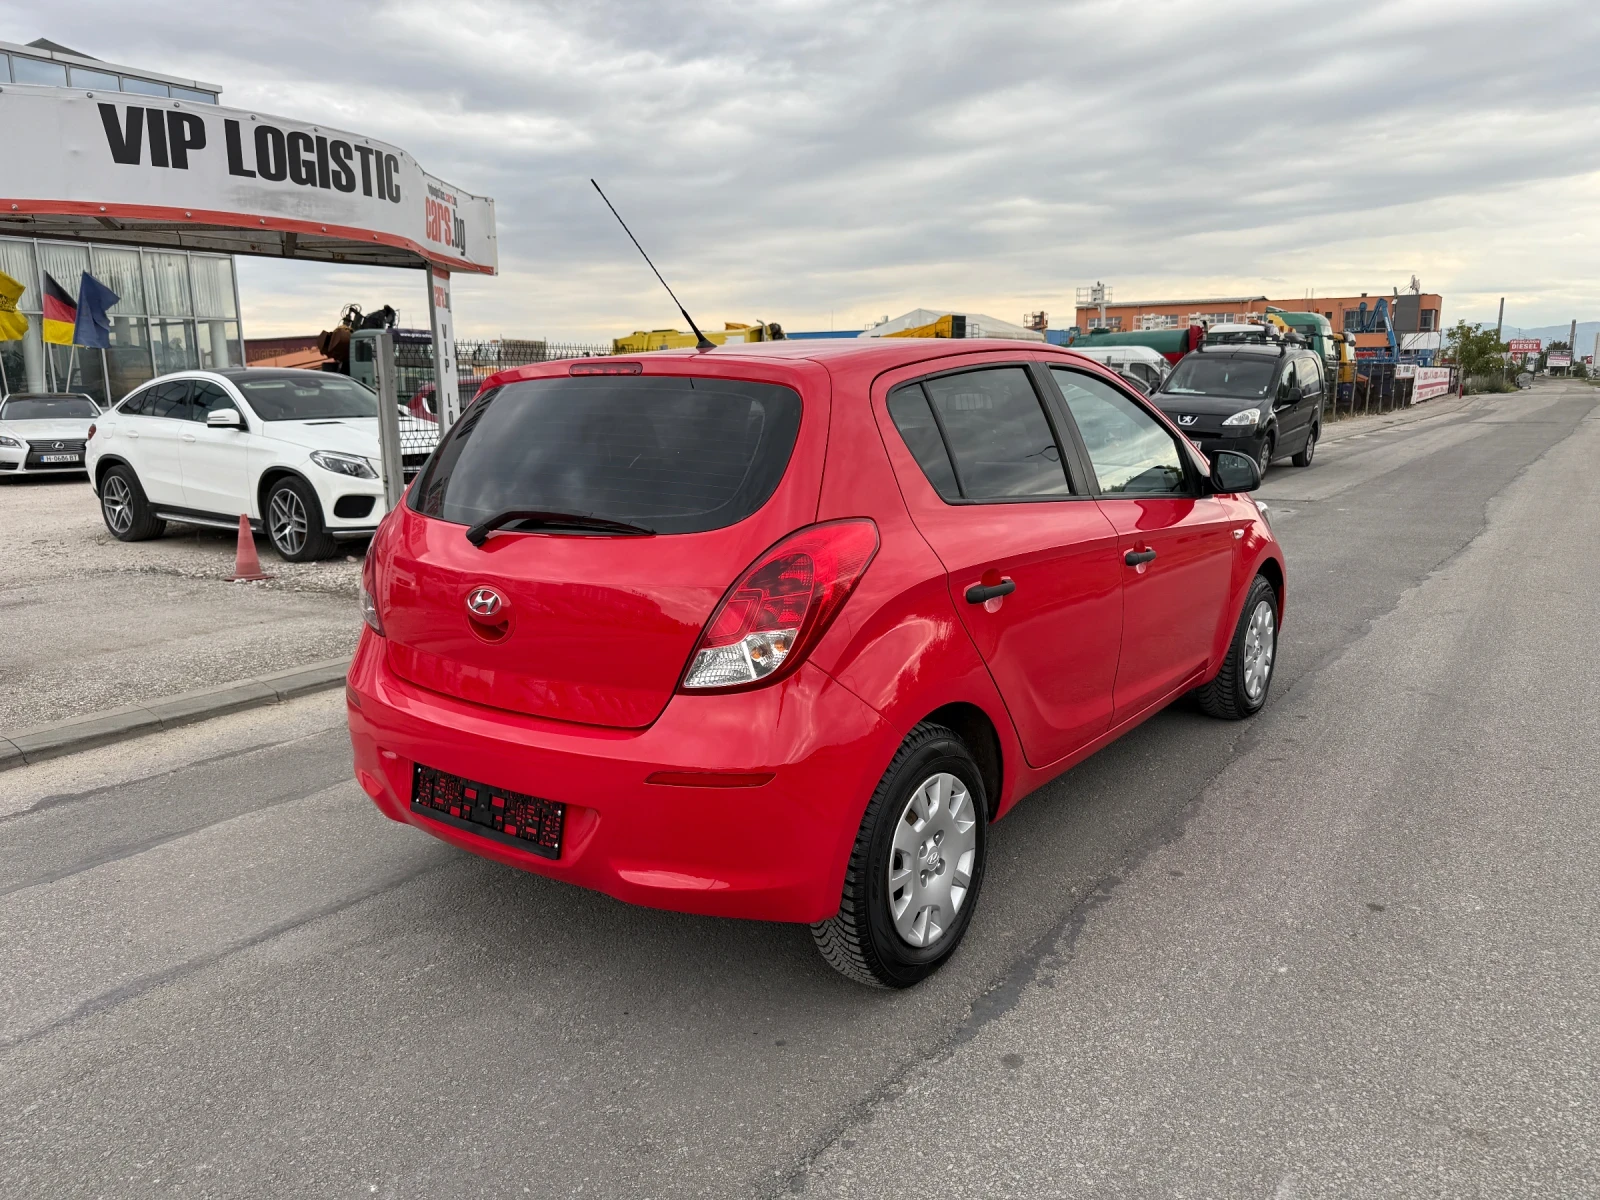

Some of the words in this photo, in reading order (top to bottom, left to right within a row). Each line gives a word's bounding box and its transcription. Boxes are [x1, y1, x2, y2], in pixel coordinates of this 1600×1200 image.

[97, 103, 206, 170] VIP
[224, 119, 401, 204] LOGISTIC
[425, 196, 466, 256] cars.bg
